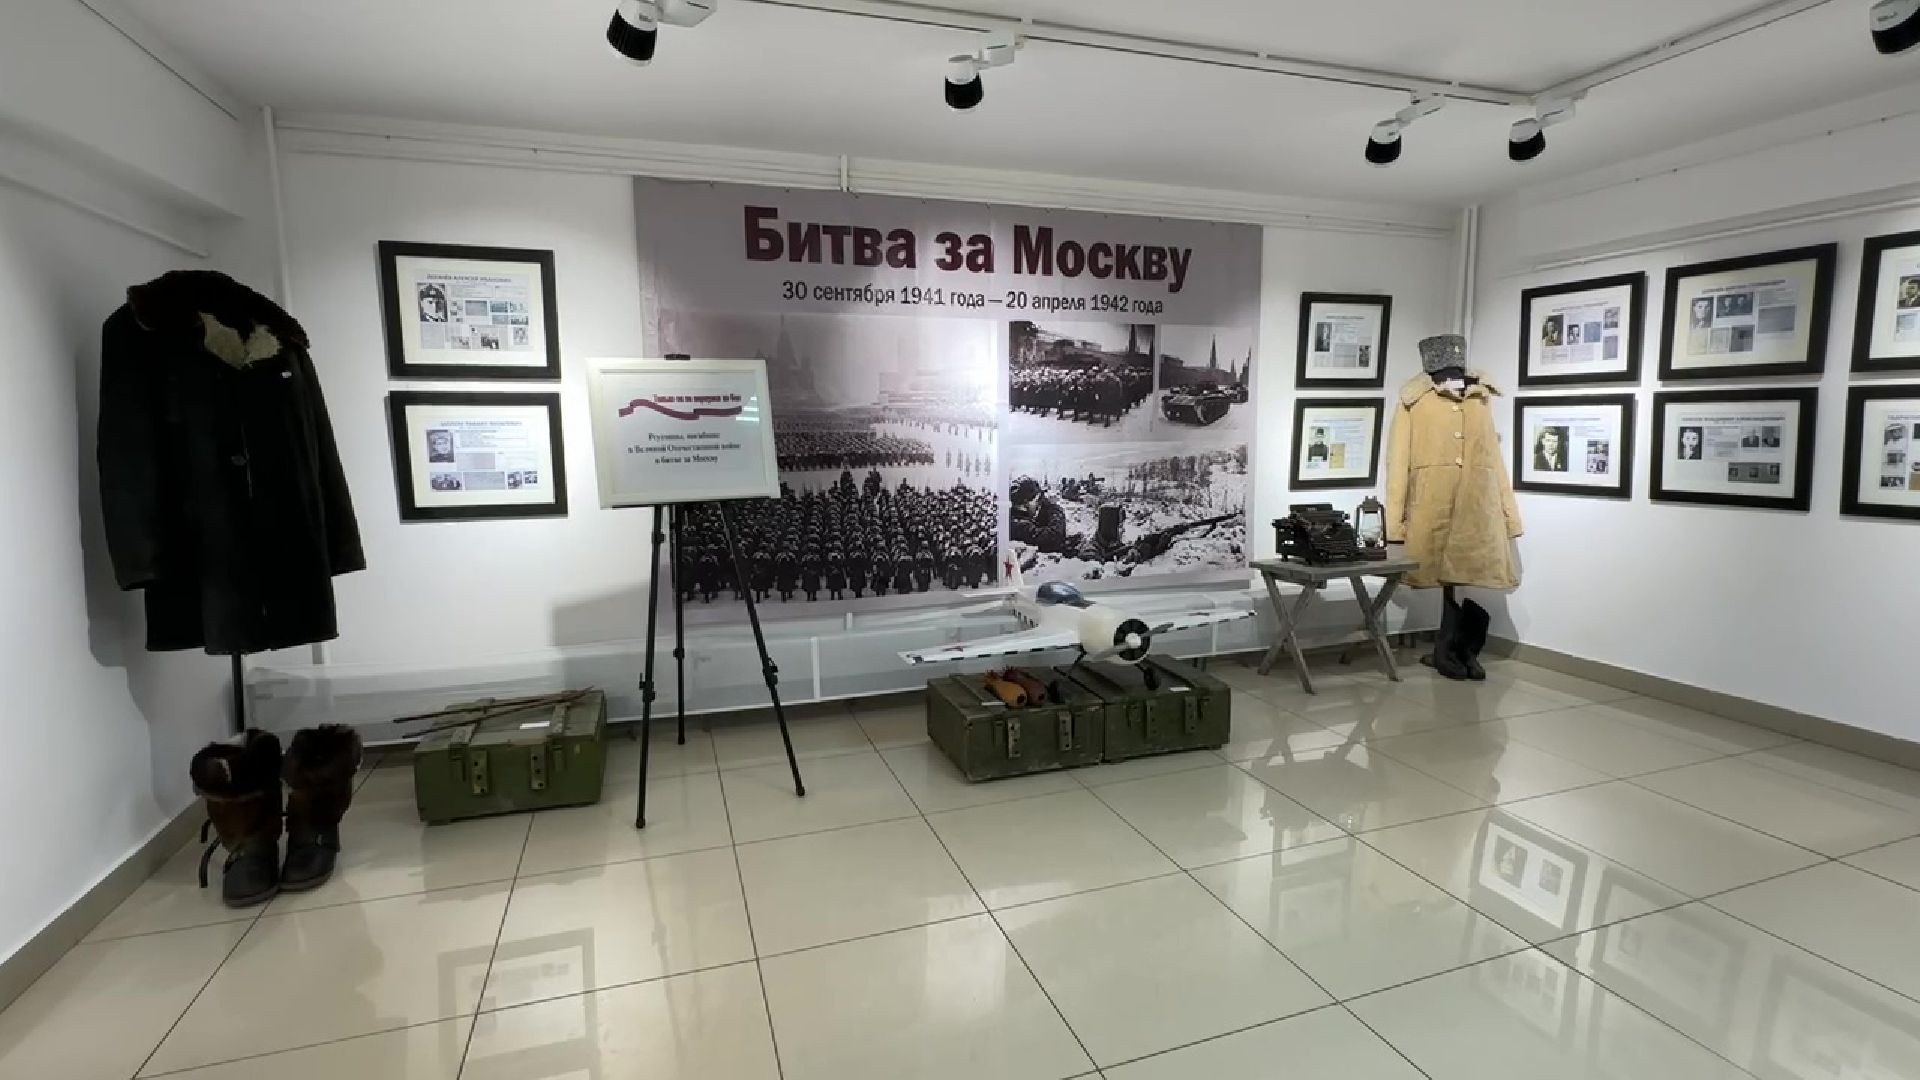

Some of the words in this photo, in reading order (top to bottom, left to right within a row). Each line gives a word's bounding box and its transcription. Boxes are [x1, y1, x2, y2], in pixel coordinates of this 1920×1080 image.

[744, 205, 917, 269] Битва
[934, 231, 994, 273] за
[1013, 224, 1193, 293] Москву
[782, 279, 808, 300] 30
[813, 283, 896, 306] сентября
[900, 285, 945, 305] 1941
[950, 290, 985, 309] года
[1005, 290, 1028, 309] 20
[1032, 294, 1086, 313] апреля
[1090, 294, 1129, 313] 1942
[1131, 298, 1164, 316] года
